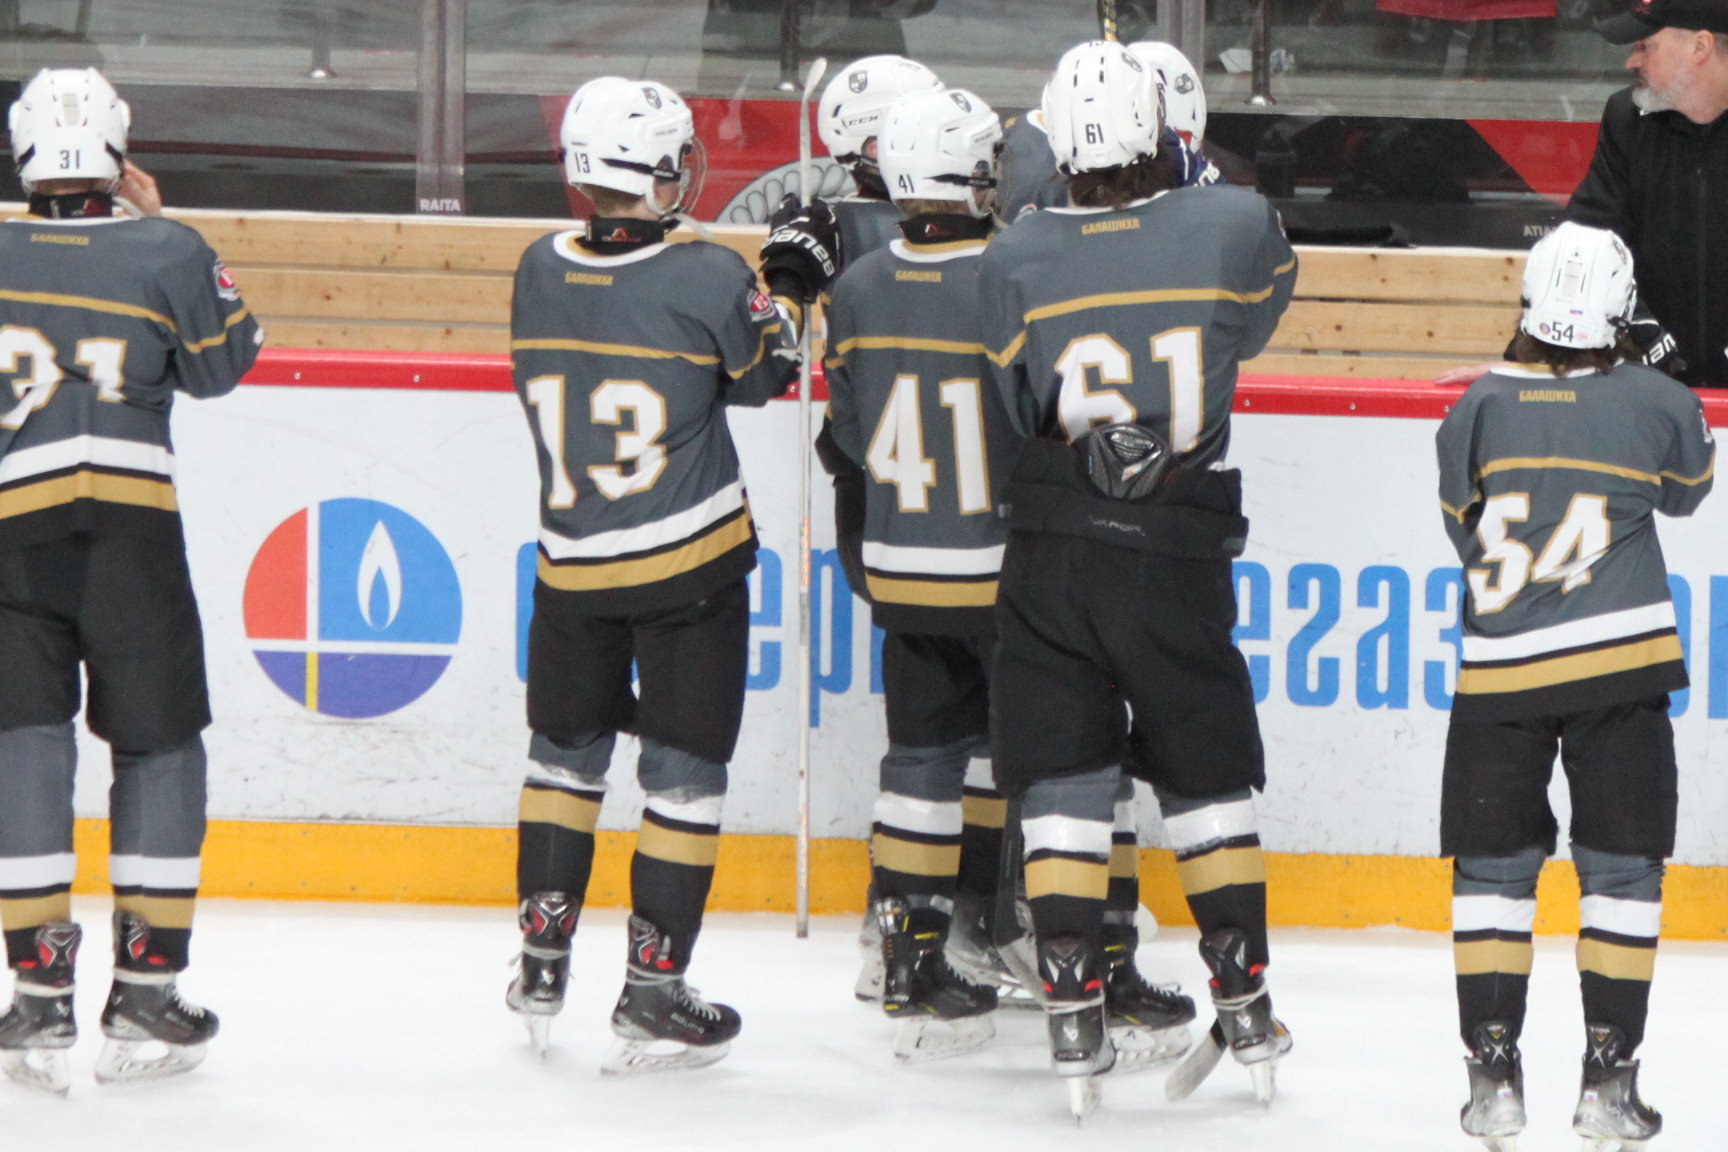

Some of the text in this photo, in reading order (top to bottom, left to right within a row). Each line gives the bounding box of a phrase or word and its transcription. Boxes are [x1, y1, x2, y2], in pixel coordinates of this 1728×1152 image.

[1084, 123, 1105, 145] 61
[60, 149, 82, 170] 31
[573, 152, 592, 175] 13
[898, 174, 915, 194] 41
[419, 198, 461, 212] RAITA
[1082, 217, 1141, 236] БАЛАШИХА
[1551, 321, 1575, 344] 54
[1054, 325, 1205, 454] 61
[1519, 389, 1577, 403] БАЛАШИХА
[526, 374, 668, 510] 13
[865, 373, 992, 515] 41
[1468, 491, 1612, 616] 54
